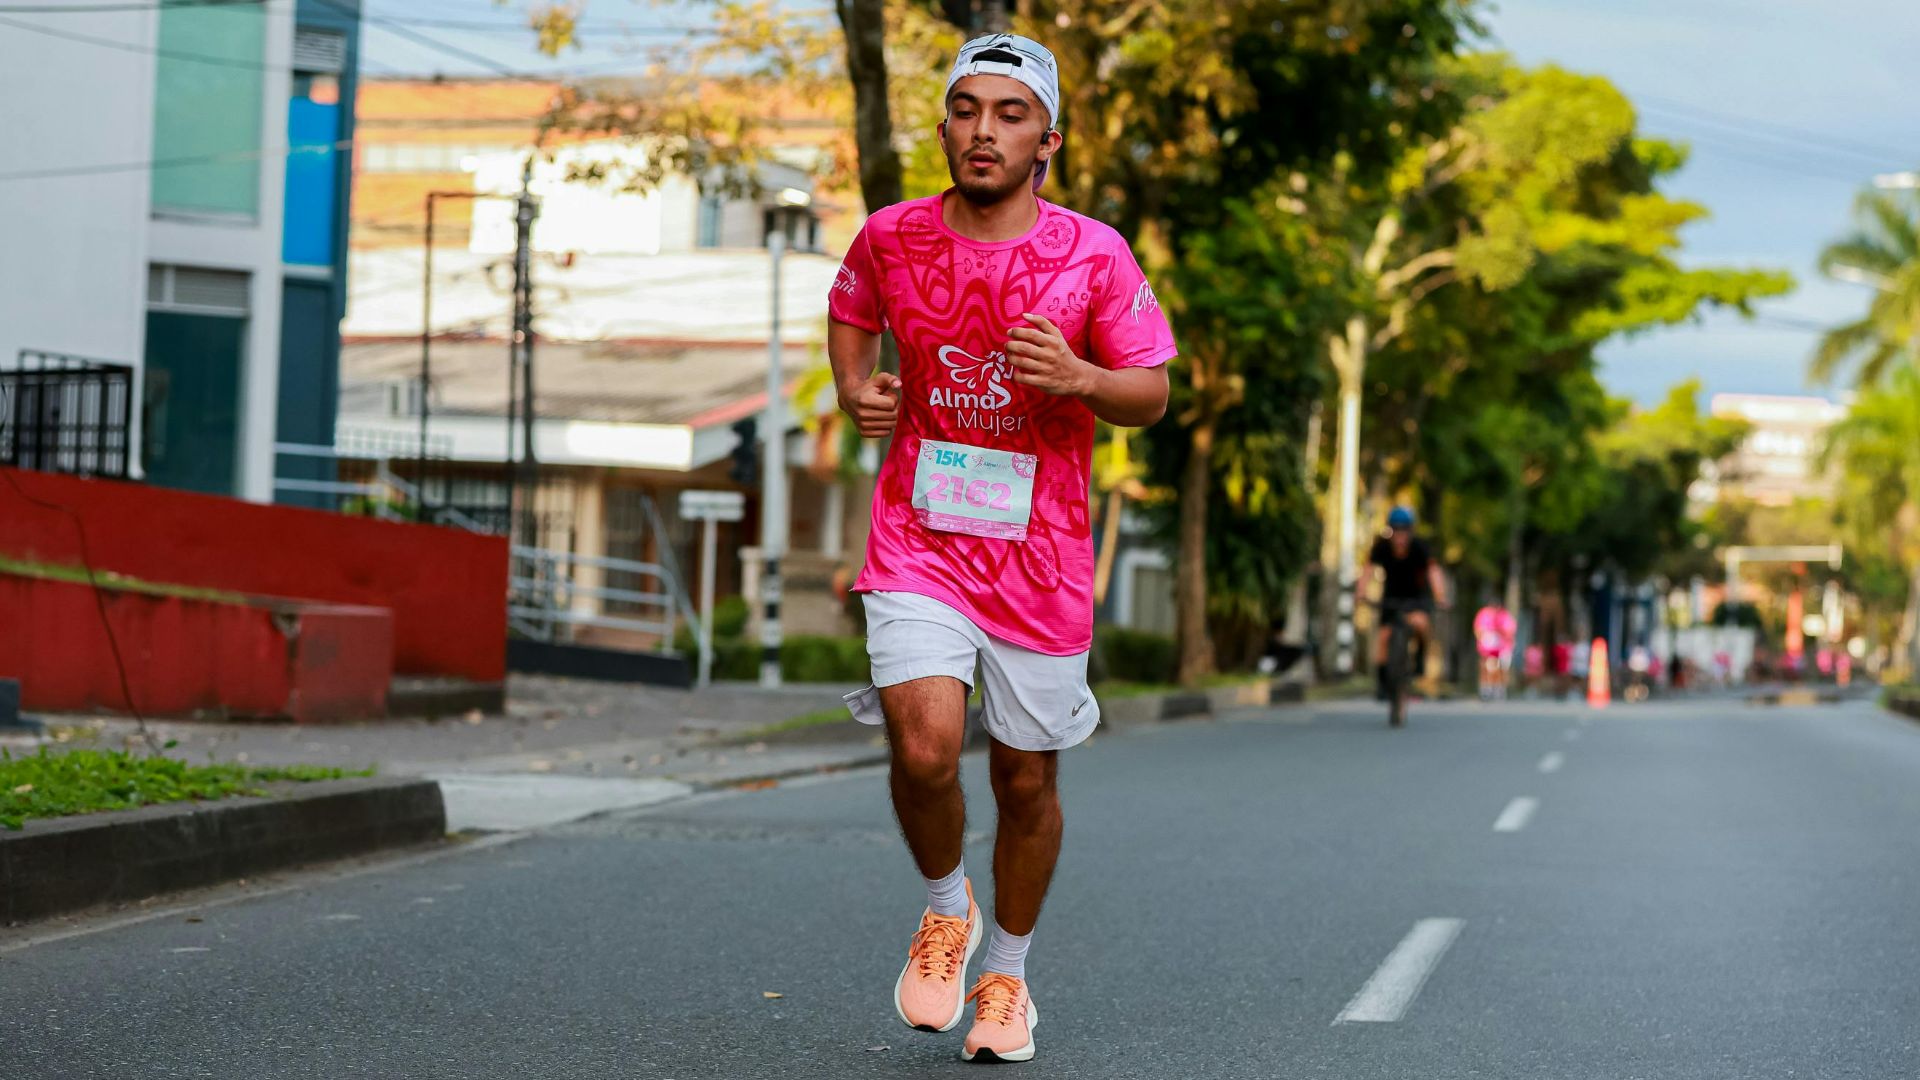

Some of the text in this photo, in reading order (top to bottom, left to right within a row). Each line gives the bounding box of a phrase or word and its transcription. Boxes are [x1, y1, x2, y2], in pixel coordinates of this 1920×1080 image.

[957, 409, 1026, 437] Mujer
[935, 449, 968, 469] 15K
[927, 472, 1012, 512] 2162
